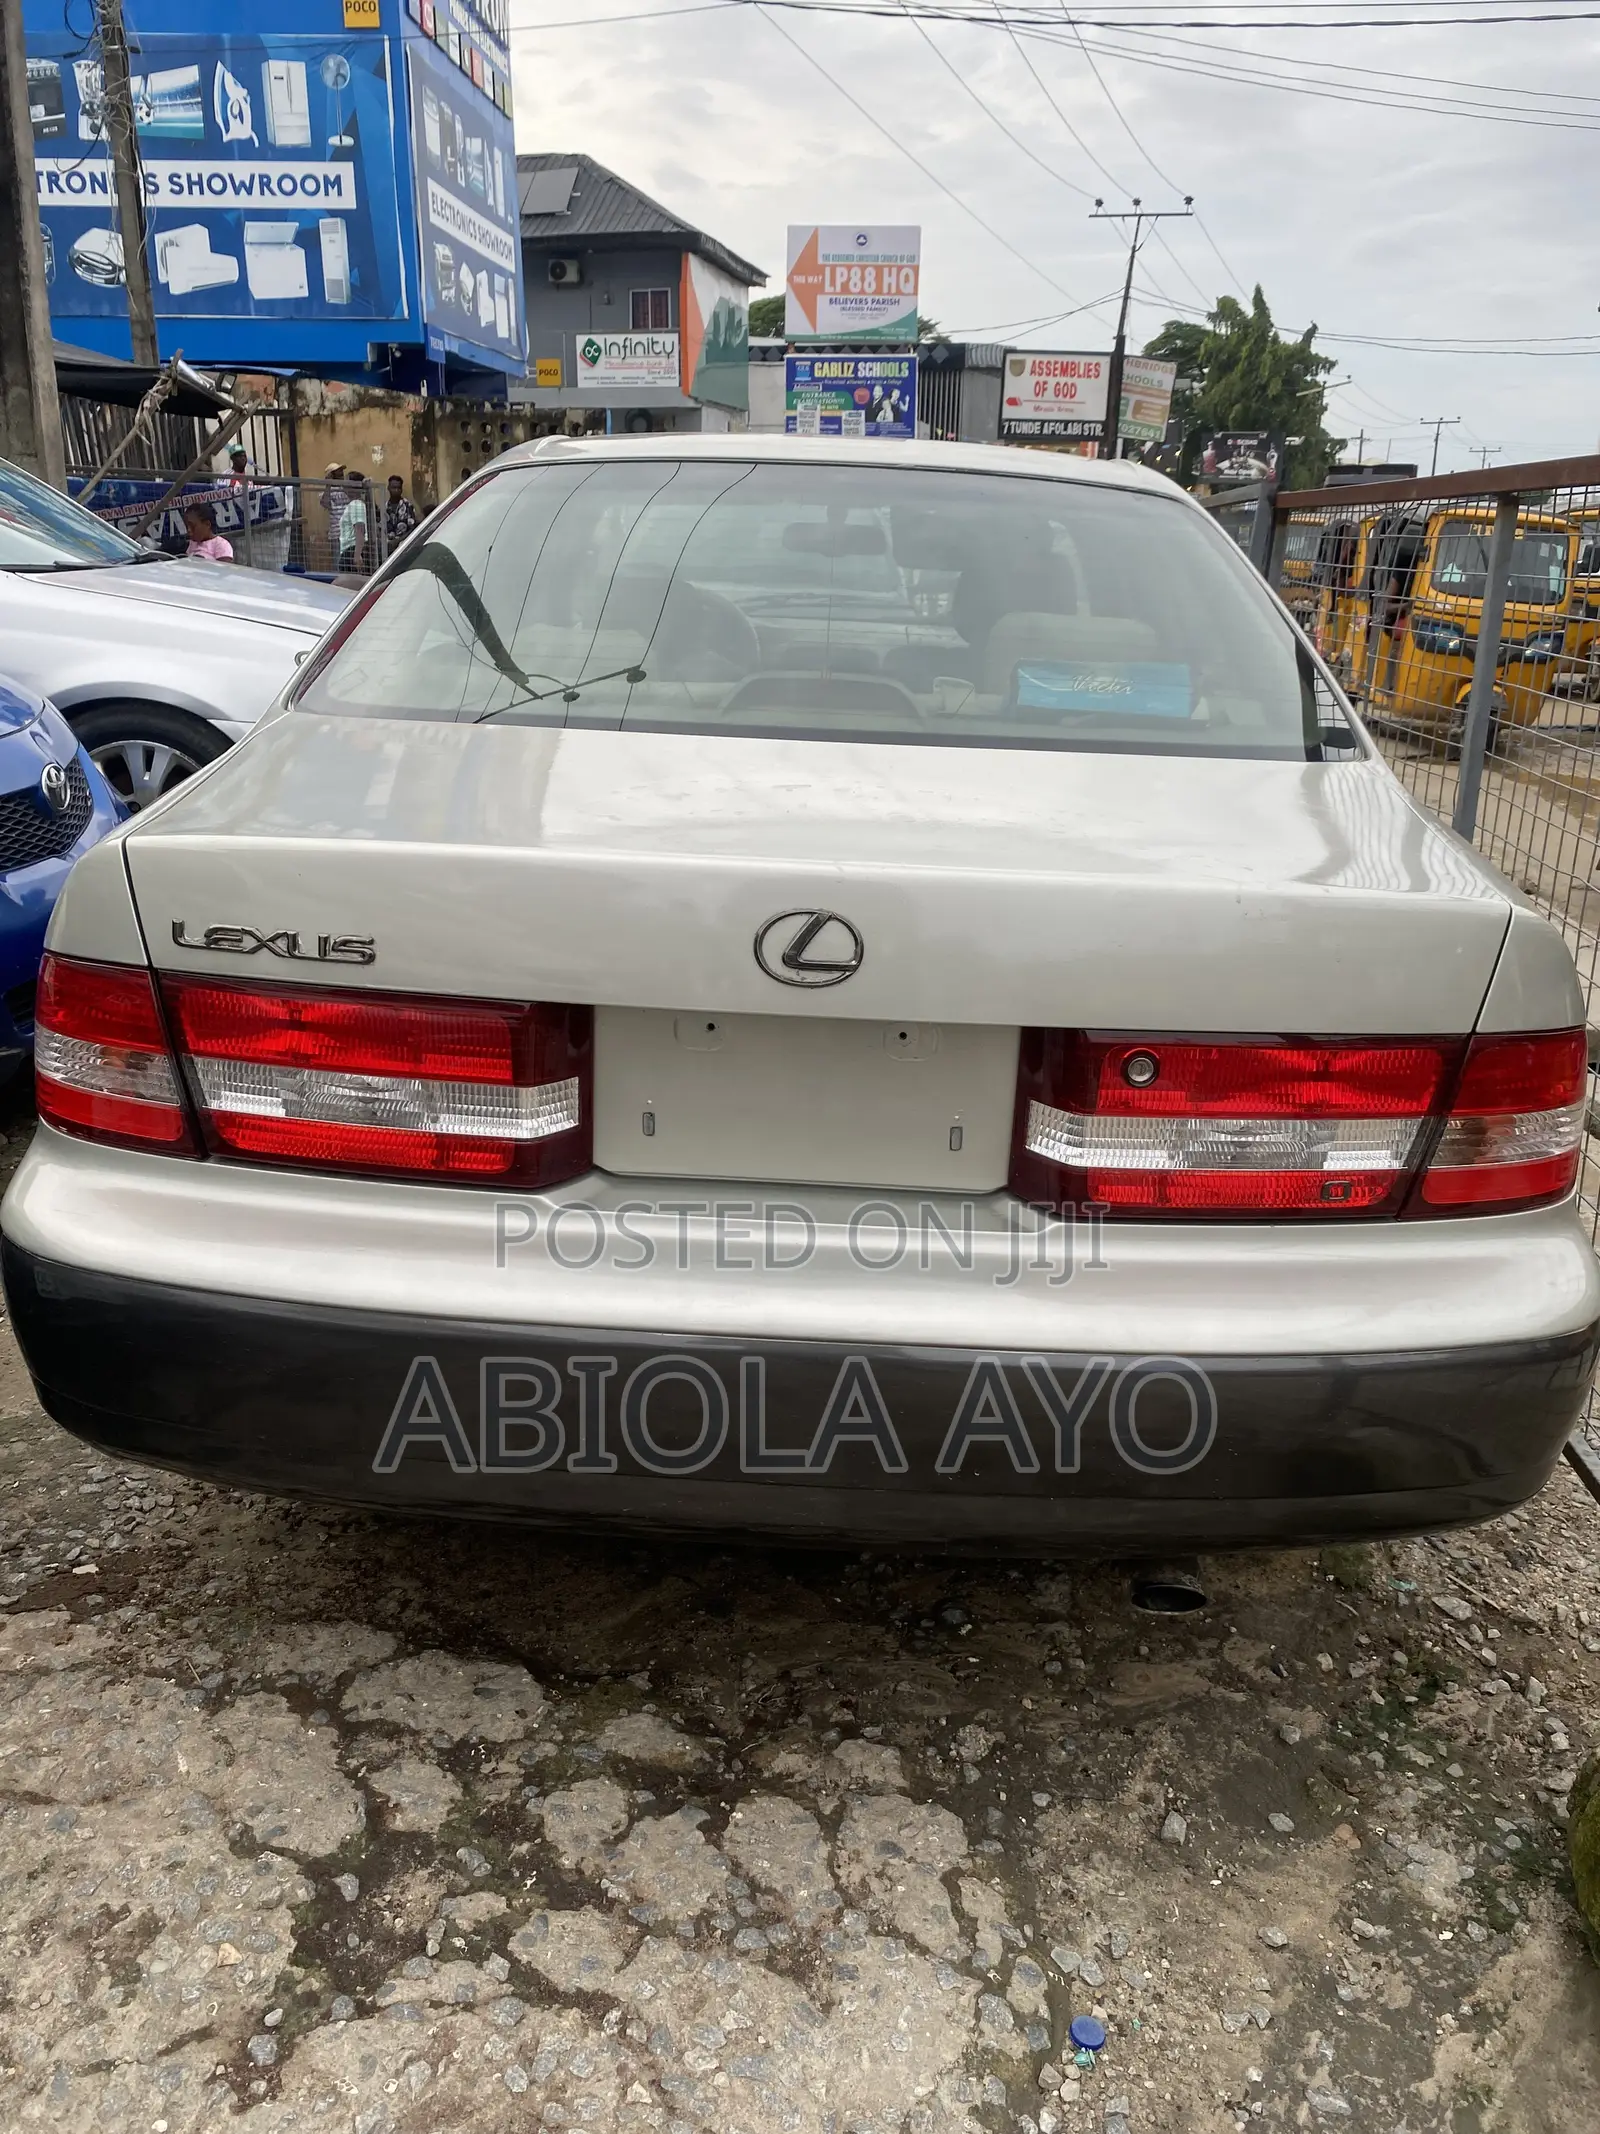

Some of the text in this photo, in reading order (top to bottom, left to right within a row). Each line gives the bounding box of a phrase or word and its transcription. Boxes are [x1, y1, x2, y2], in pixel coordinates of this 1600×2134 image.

[345, 0, 377, 13] POCO
[168, 172, 343, 197] SHOWROOM
[431, 191, 514, 264] ELECTRONICS SHOWROOM
[807, 275, 822, 284] WAY
[824, 266, 915, 294] LP88 HQ
[829, 297, 900, 306] BELIEVERS PARISH
[603, 336, 675, 360] Infinity
[538, 368, 559, 376] POCO
[814, 361, 855, 378] GABLIZ
[857, 361, 909, 378] SCHOOLS
[1029, 359, 1101, 379] ASSEMBLIES
[1034, 381, 1077, 399] OF GOD
[1010, 421, 1042, 435] TUNDE
[1042, 421, 1082, 436] AFOLABI
[212, 486, 286, 528] CAR
[171, 917, 376, 965] LEXUS
